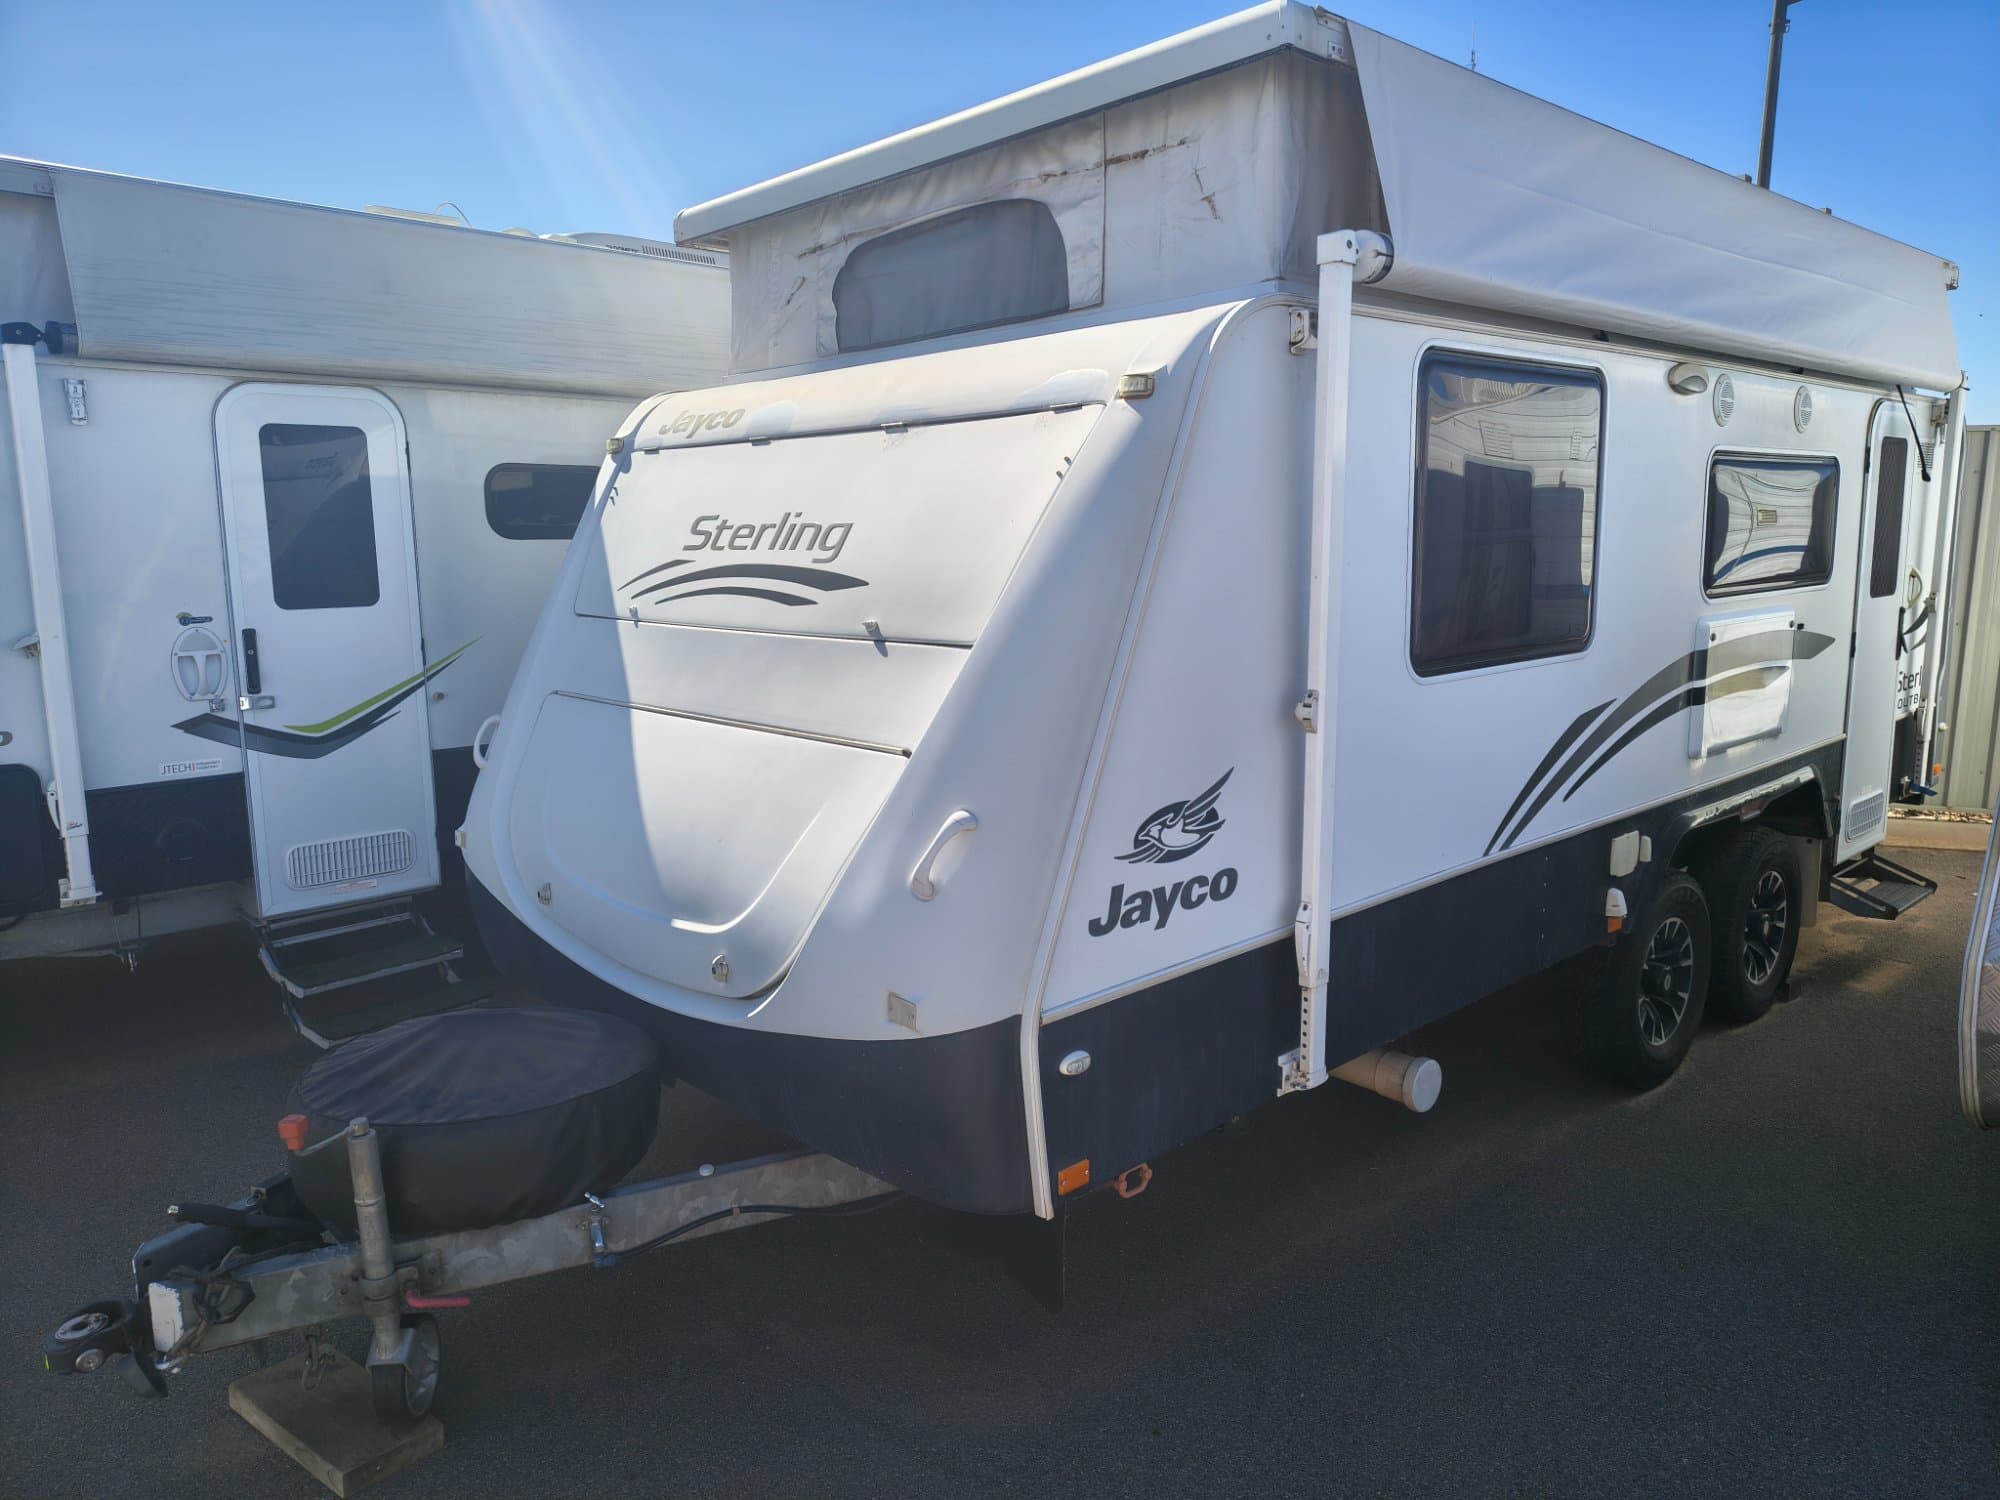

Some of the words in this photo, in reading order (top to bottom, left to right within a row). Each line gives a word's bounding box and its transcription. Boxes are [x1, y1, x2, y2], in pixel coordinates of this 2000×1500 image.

[658, 408, 746, 439] Jayco
[682, 512, 854, 564] Sterling
[1897, 665, 1923, 692] Sterl
[161, 762, 192, 776] JTECH
[1088, 867, 1239, 938] Jayco
